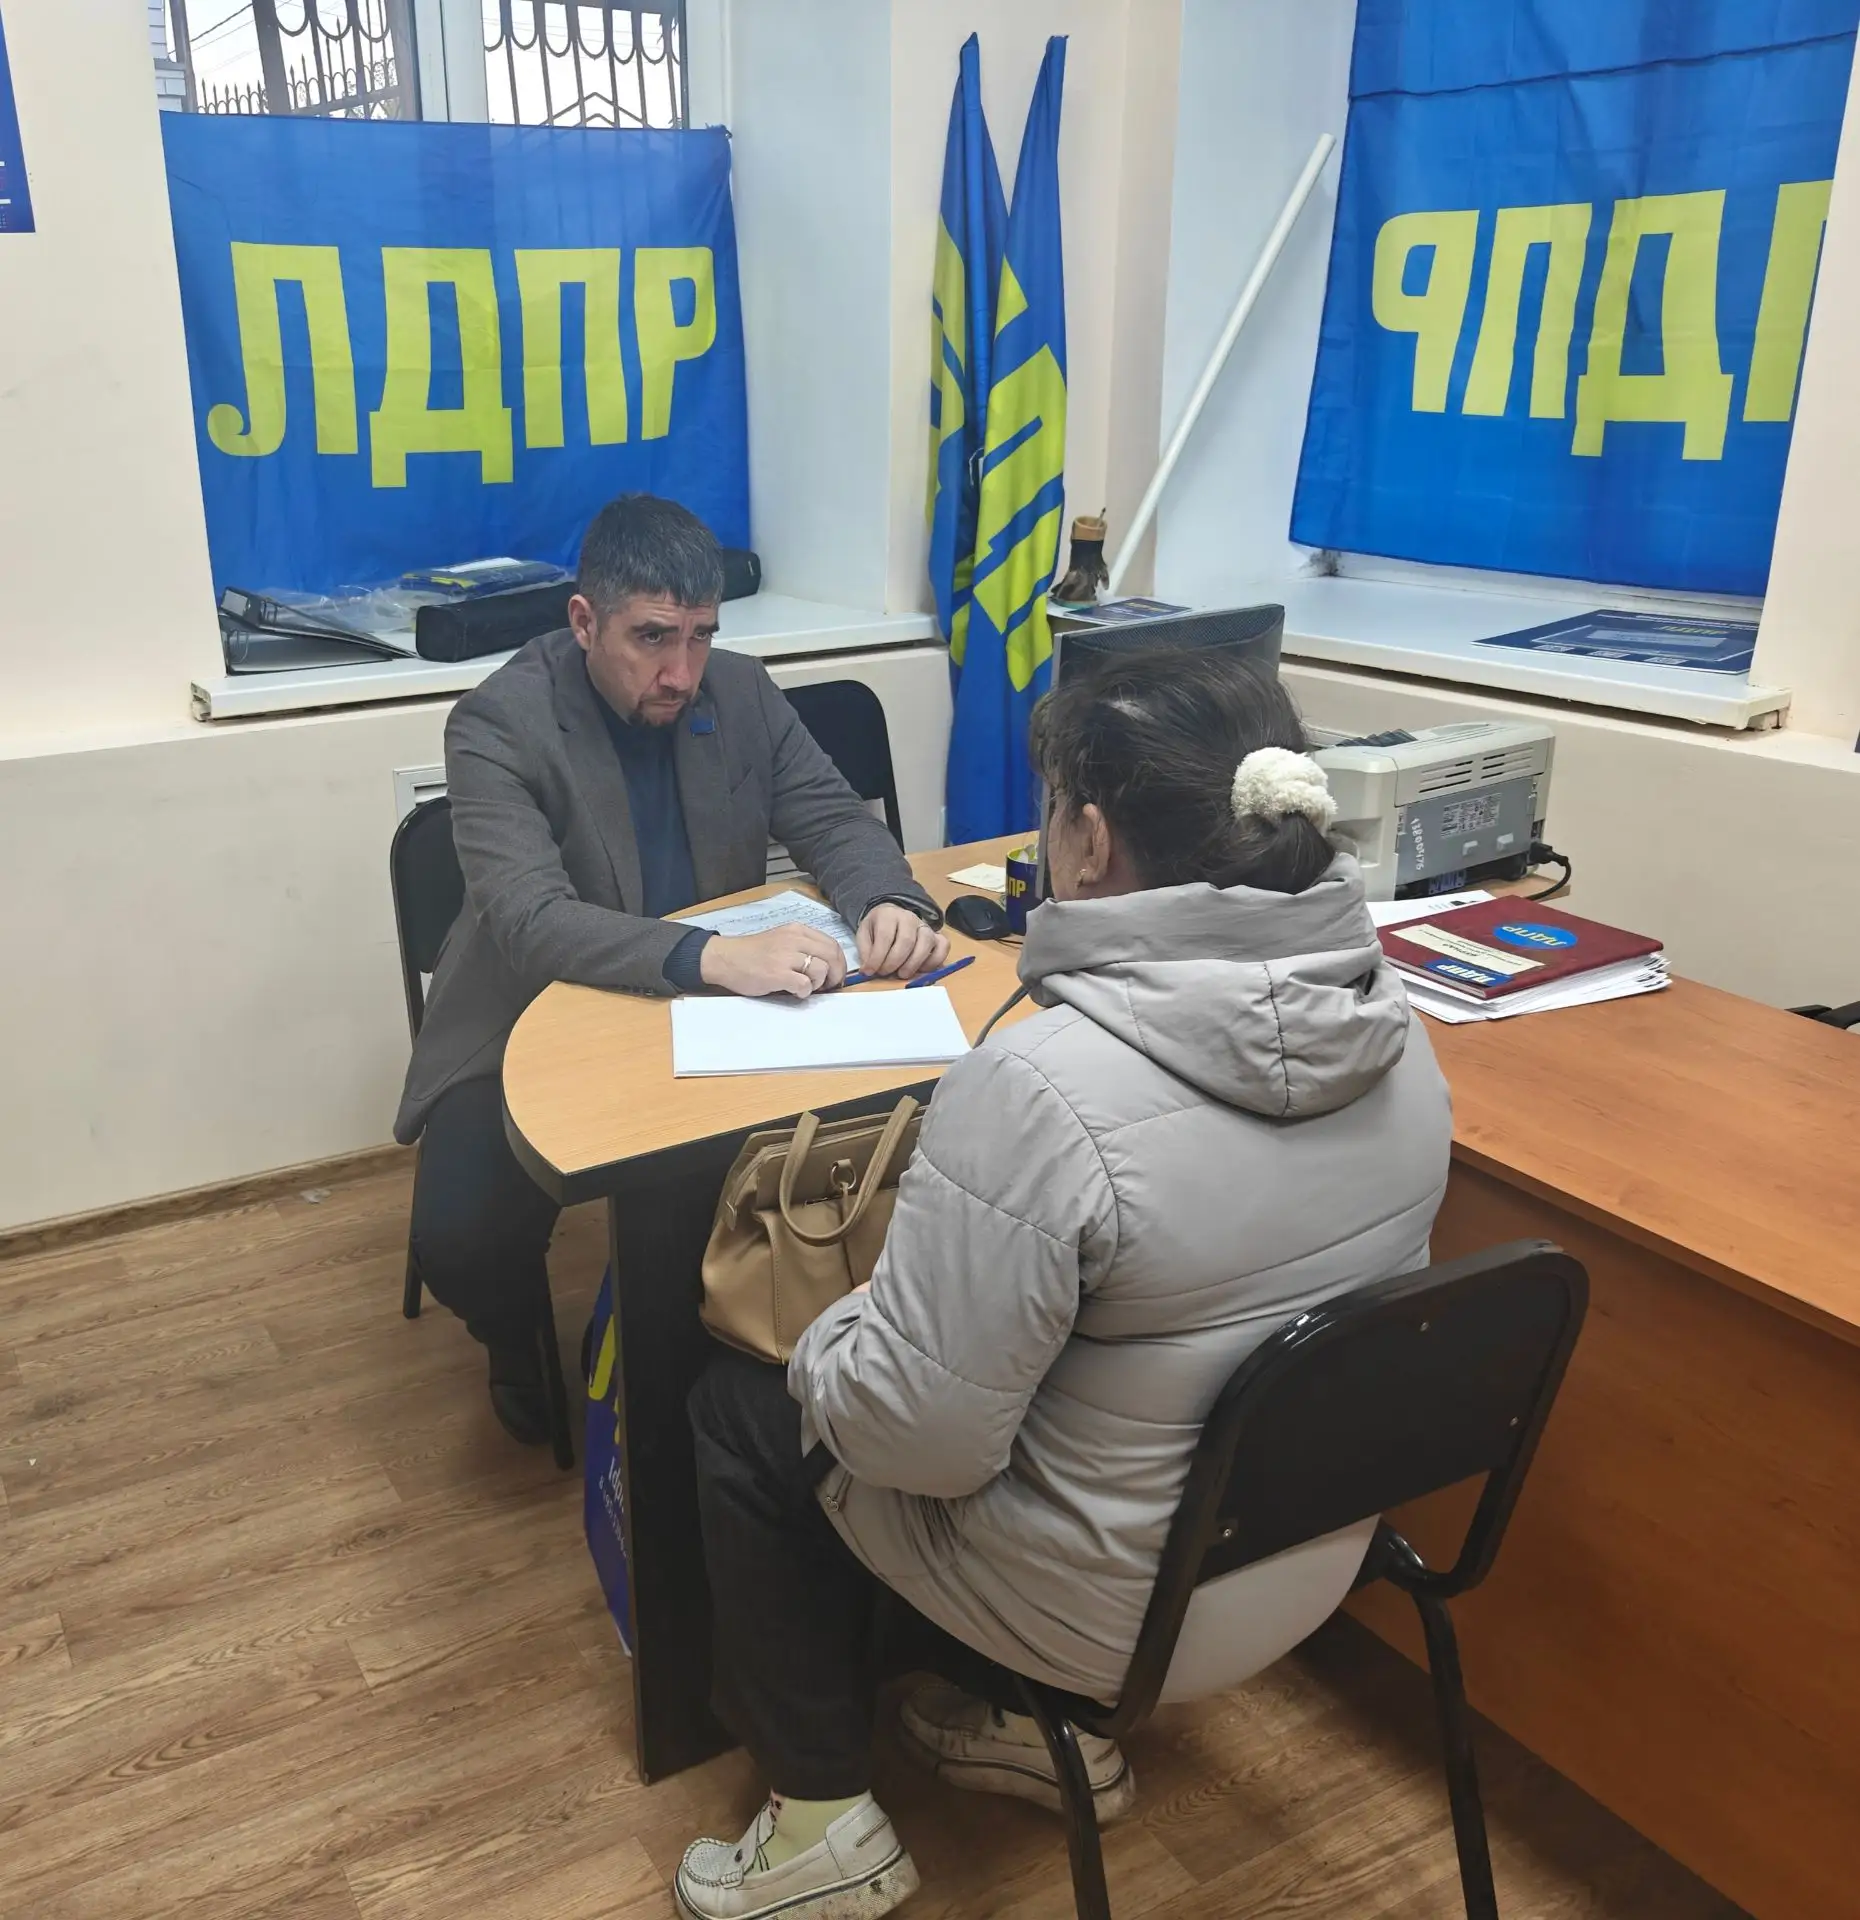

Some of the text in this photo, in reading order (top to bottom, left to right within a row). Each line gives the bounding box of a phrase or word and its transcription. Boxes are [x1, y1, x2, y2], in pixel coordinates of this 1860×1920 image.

[207, 242, 716, 488] ЛДПР
[1007, 876, 1026, 898] ПР
[1502, 926, 1567, 946] ЛДПР
[1436, 964, 1496, 983] ЛДПР
